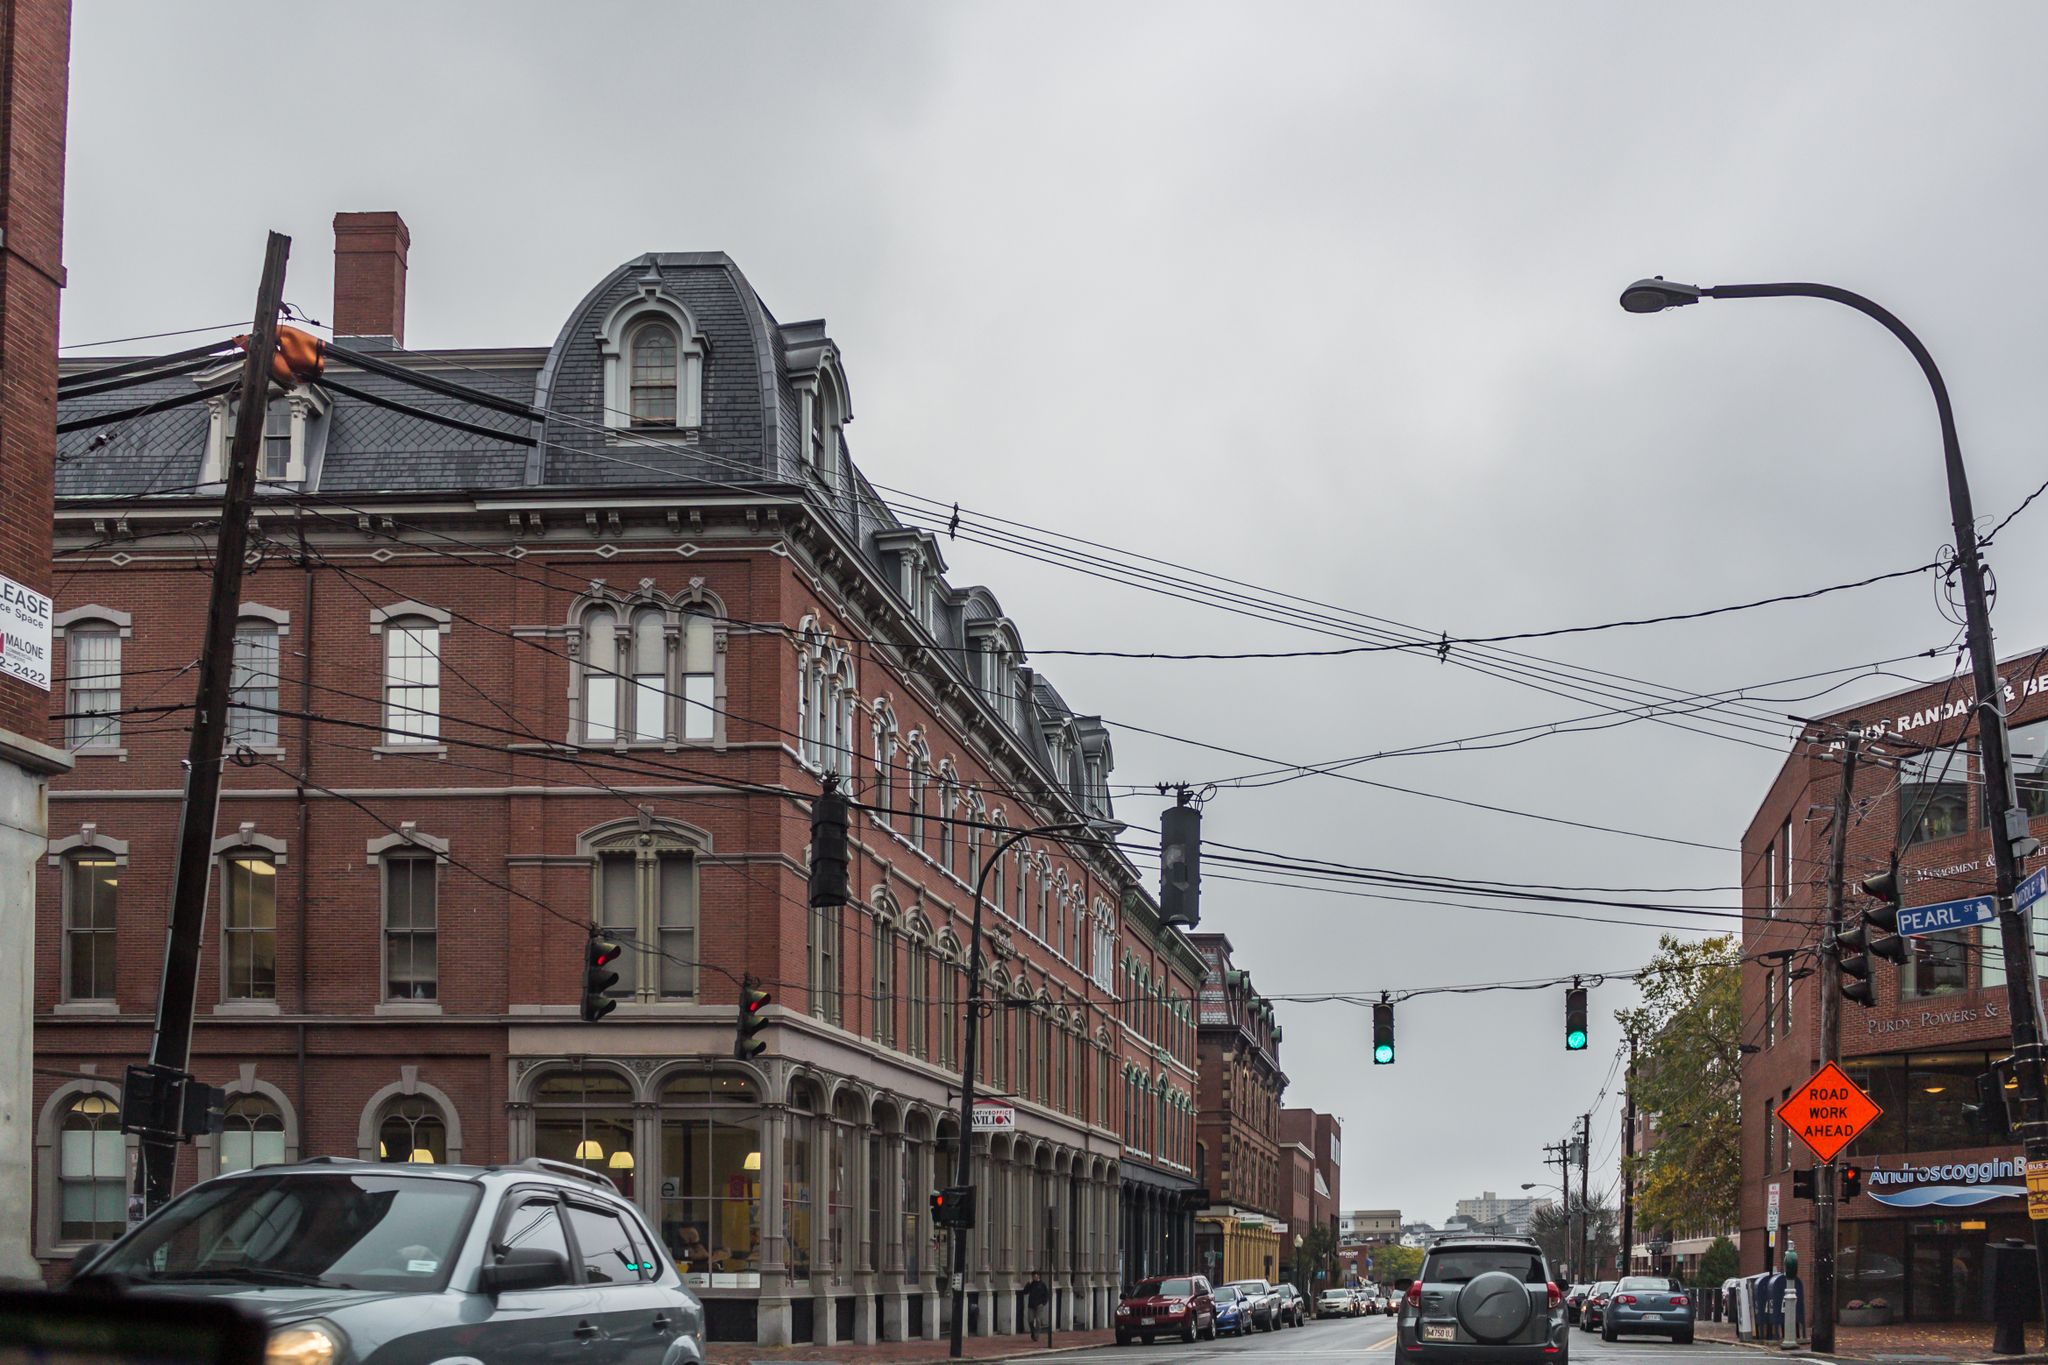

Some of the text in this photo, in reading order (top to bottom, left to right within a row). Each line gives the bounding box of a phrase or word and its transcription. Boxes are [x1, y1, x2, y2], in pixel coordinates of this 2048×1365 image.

[0, 583, 48, 619] EASE
[15, 608, 44, 629] Space
[6, 633, 43, 660] MALONE
[2003, 685, 2016, 702] &
[1917, 860, 1979, 881] MANAGEMENT
[1901, 904, 1974, 931] PEARL ST
[1867, 1003, 1998, 1034] PURDY POWERS &
[1810, 1088, 1849, 1100] ROAD
[1810, 1107, 1848, 1119] WORK
[1804, 1125, 1854, 1137] AHEAD
